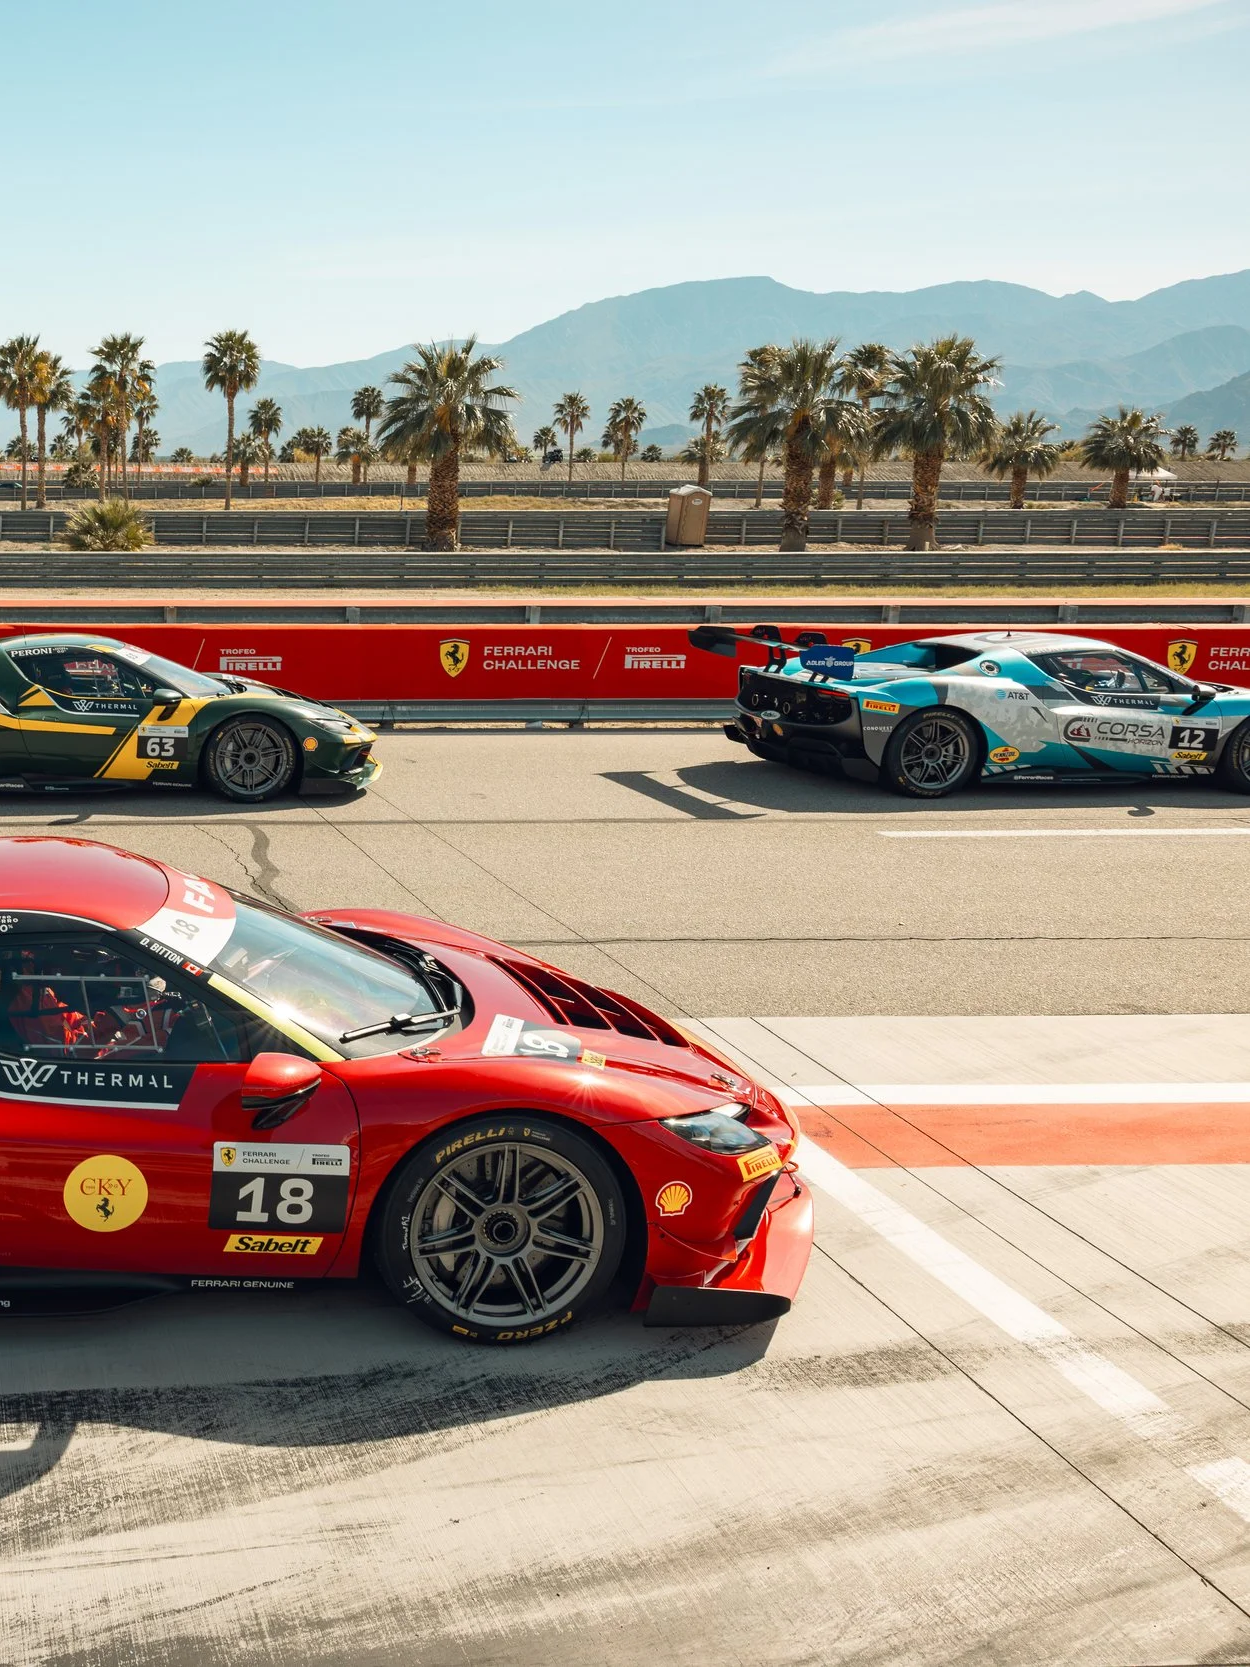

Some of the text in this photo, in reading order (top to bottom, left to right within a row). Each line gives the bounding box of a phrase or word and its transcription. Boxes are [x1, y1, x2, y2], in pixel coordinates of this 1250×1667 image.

[10, 647, 53, 658] PERONI
[483, 646, 553, 656] FERRARI
[219, 656, 283, 671] PIRELLI
[483, 659, 580, 671] CHALLENGE
[624, 654, 687, 669] PIRELLI
[1007, 691, 1030, 701] AT&T
[865, 700, 896, 712] PIRELLI
[1096, 721, 1165, 739] CORSA
[1126, 738, 1165, 746] HORIZON
[1178, 729, 1206, 749] 12
[146, 737, 175, 757] 63
[993, 750, 1016, 759] PENNZOIL
[1175, 751, 1203, 760] Sabelt
[146, 761, 174, 769] Sabelt
[170, 918, 200, 941] 18
[139, 937, 184, 965] D. BITTON
[60, 1070, 173, 1089] THERMAL
[435, 1127, 506, 1164] PIRELLI
[242, 1150, 276, 1158] FERRARI
[311, 1157, 342, 1166] PIRELLI
[743, 1150, 778, 1176] PIRELLI
[236, 1176, 314, 1224] 18
[234, 1236, 311, 1253] Sabelt
[191, 1279, 295, 1288] FERRARI GENUINE
